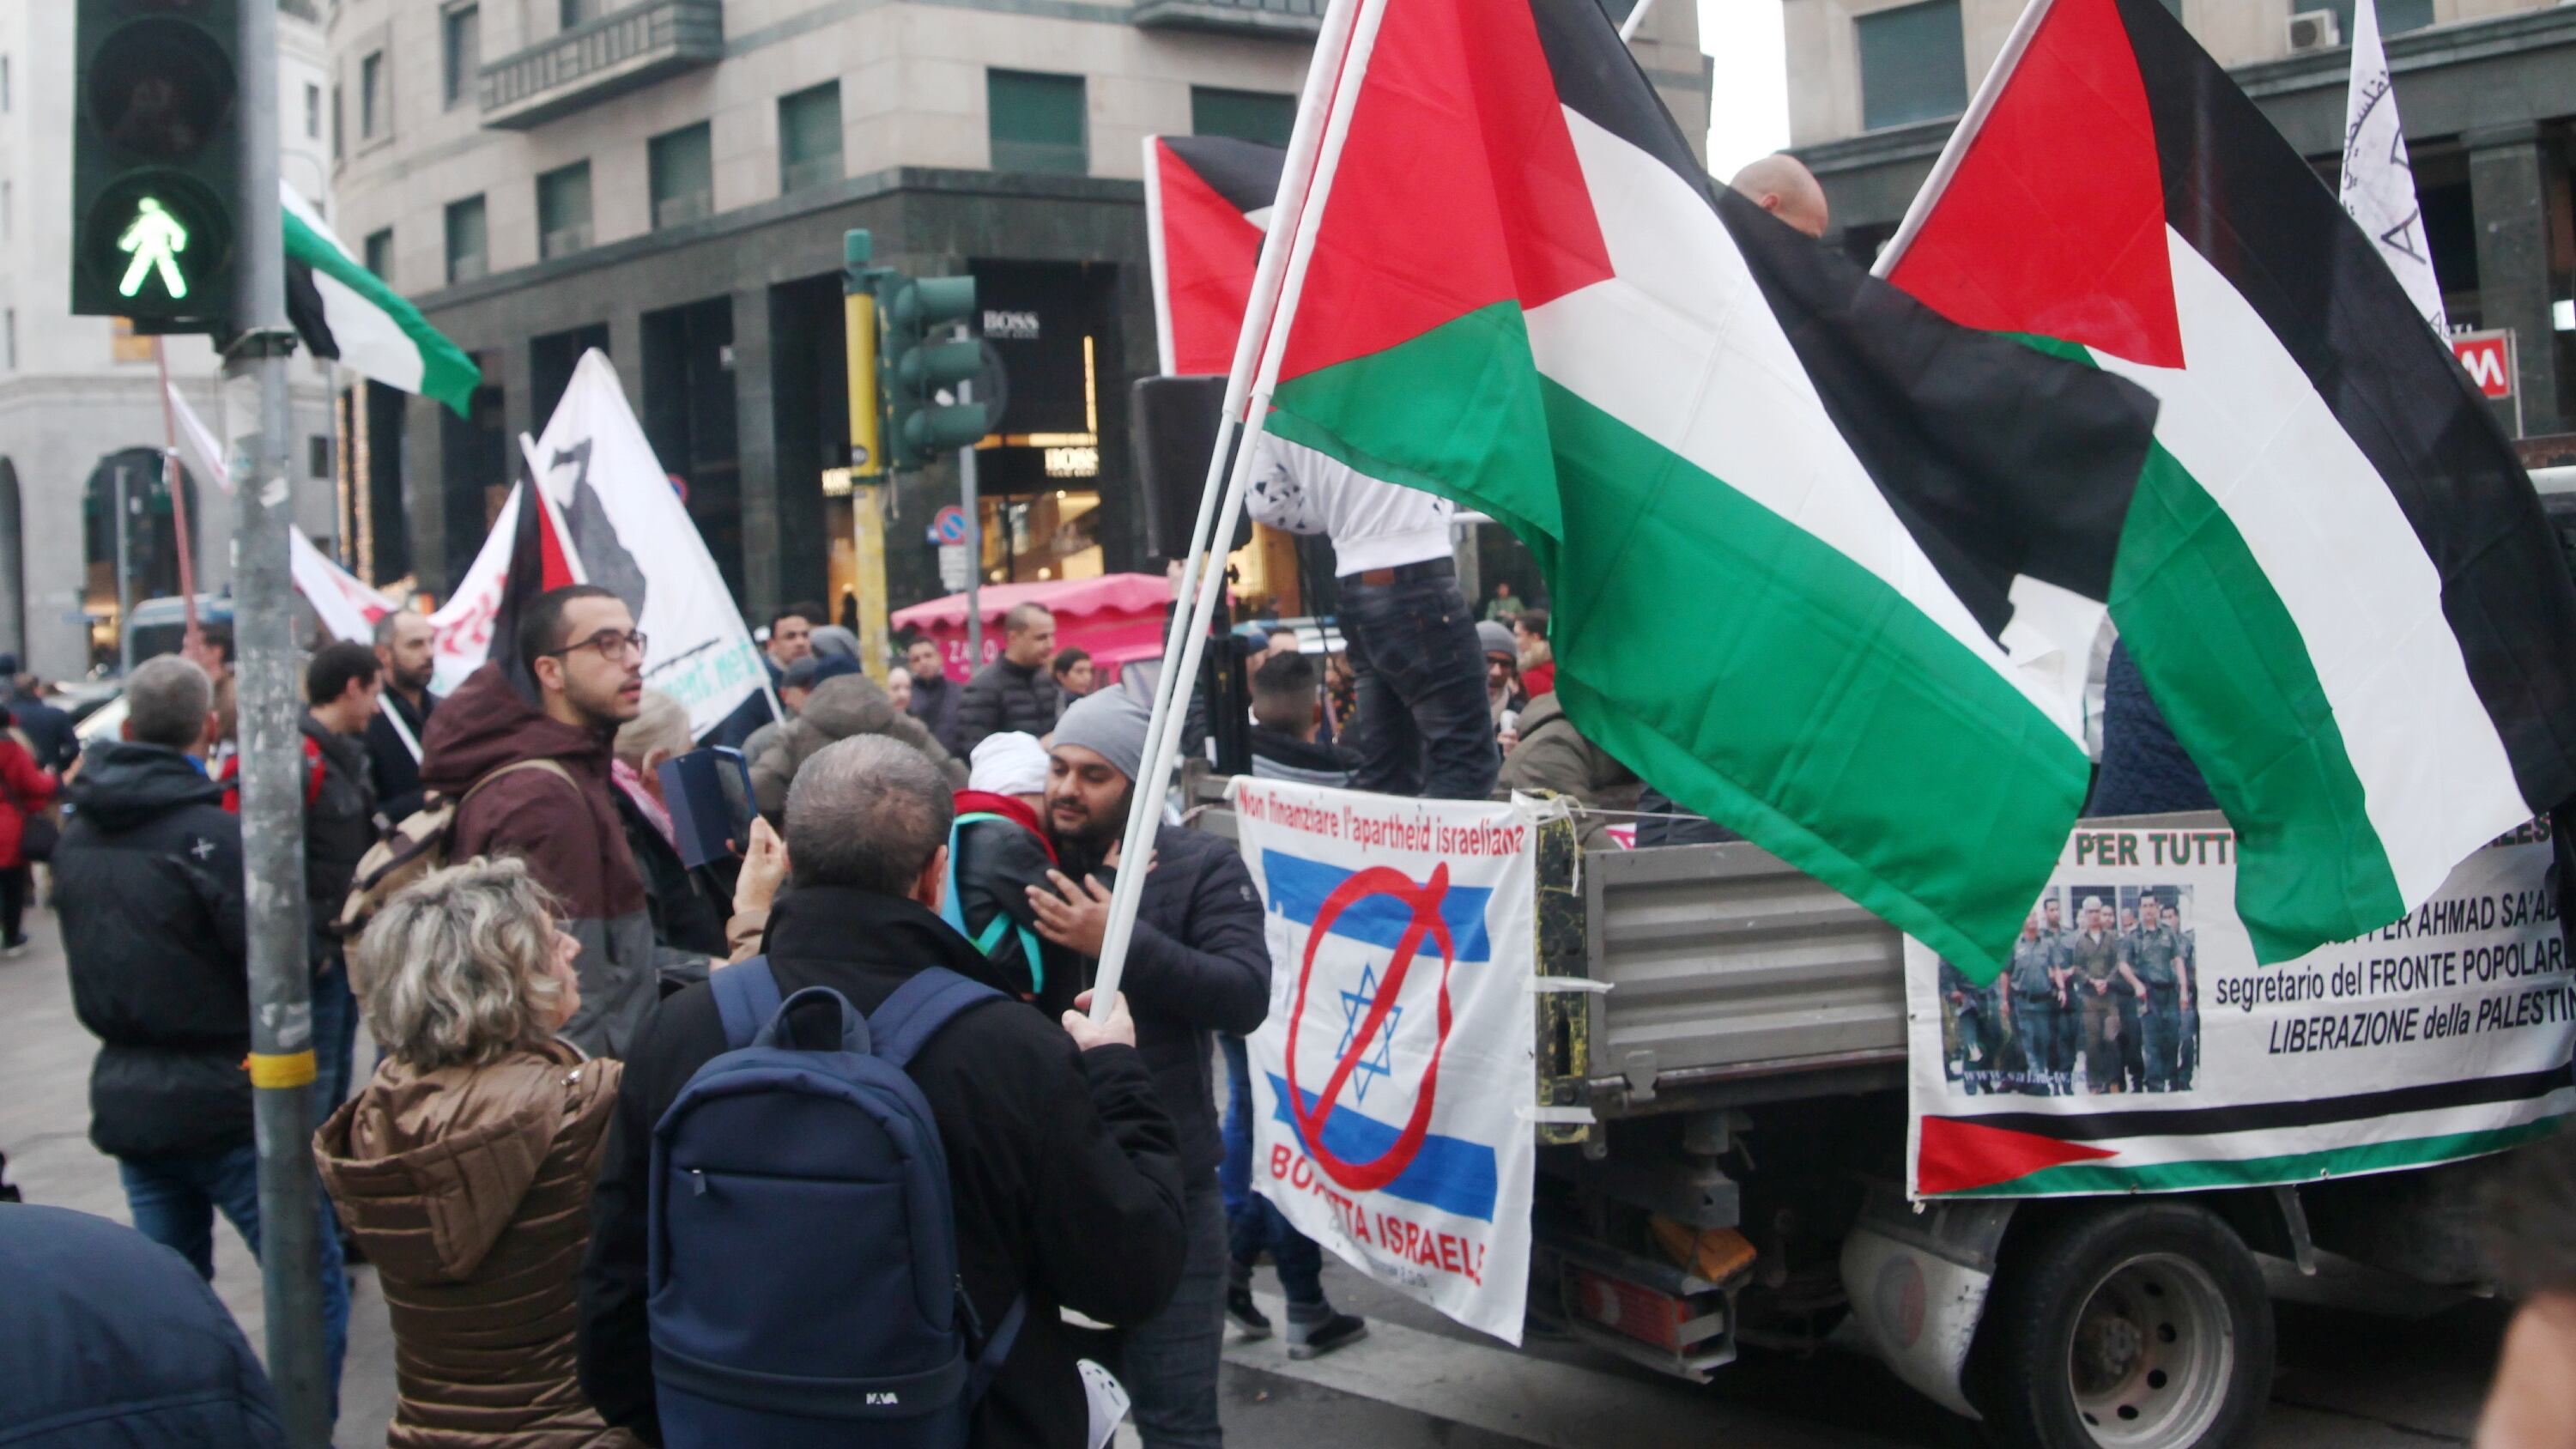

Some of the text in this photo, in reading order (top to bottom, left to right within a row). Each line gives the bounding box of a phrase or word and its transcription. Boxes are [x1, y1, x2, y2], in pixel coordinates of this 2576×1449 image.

[984, 310, 1039, 330] BOSS
[2461, 347, 2505, 388] M
[1045, 446, 1099, 470] BOSS
[1239, 782, 1264, 820] Non
[1269, 790, 1339, 838] finanziare
[1343, 803, 1431, 853] l'apartheid
[2075, 831, 2140, 867] PER
[2417, 895, 2496, 938] AHMAD
[2215, 964, 2324, 1014] segretario
[2331, 960, 2363, 998] del
[2370, 950, 2457, 996] FRONTE
[2268, 1007, 2421, 1056] LIBERAZIONE
[2422, 1001, 2471, 1040] della
